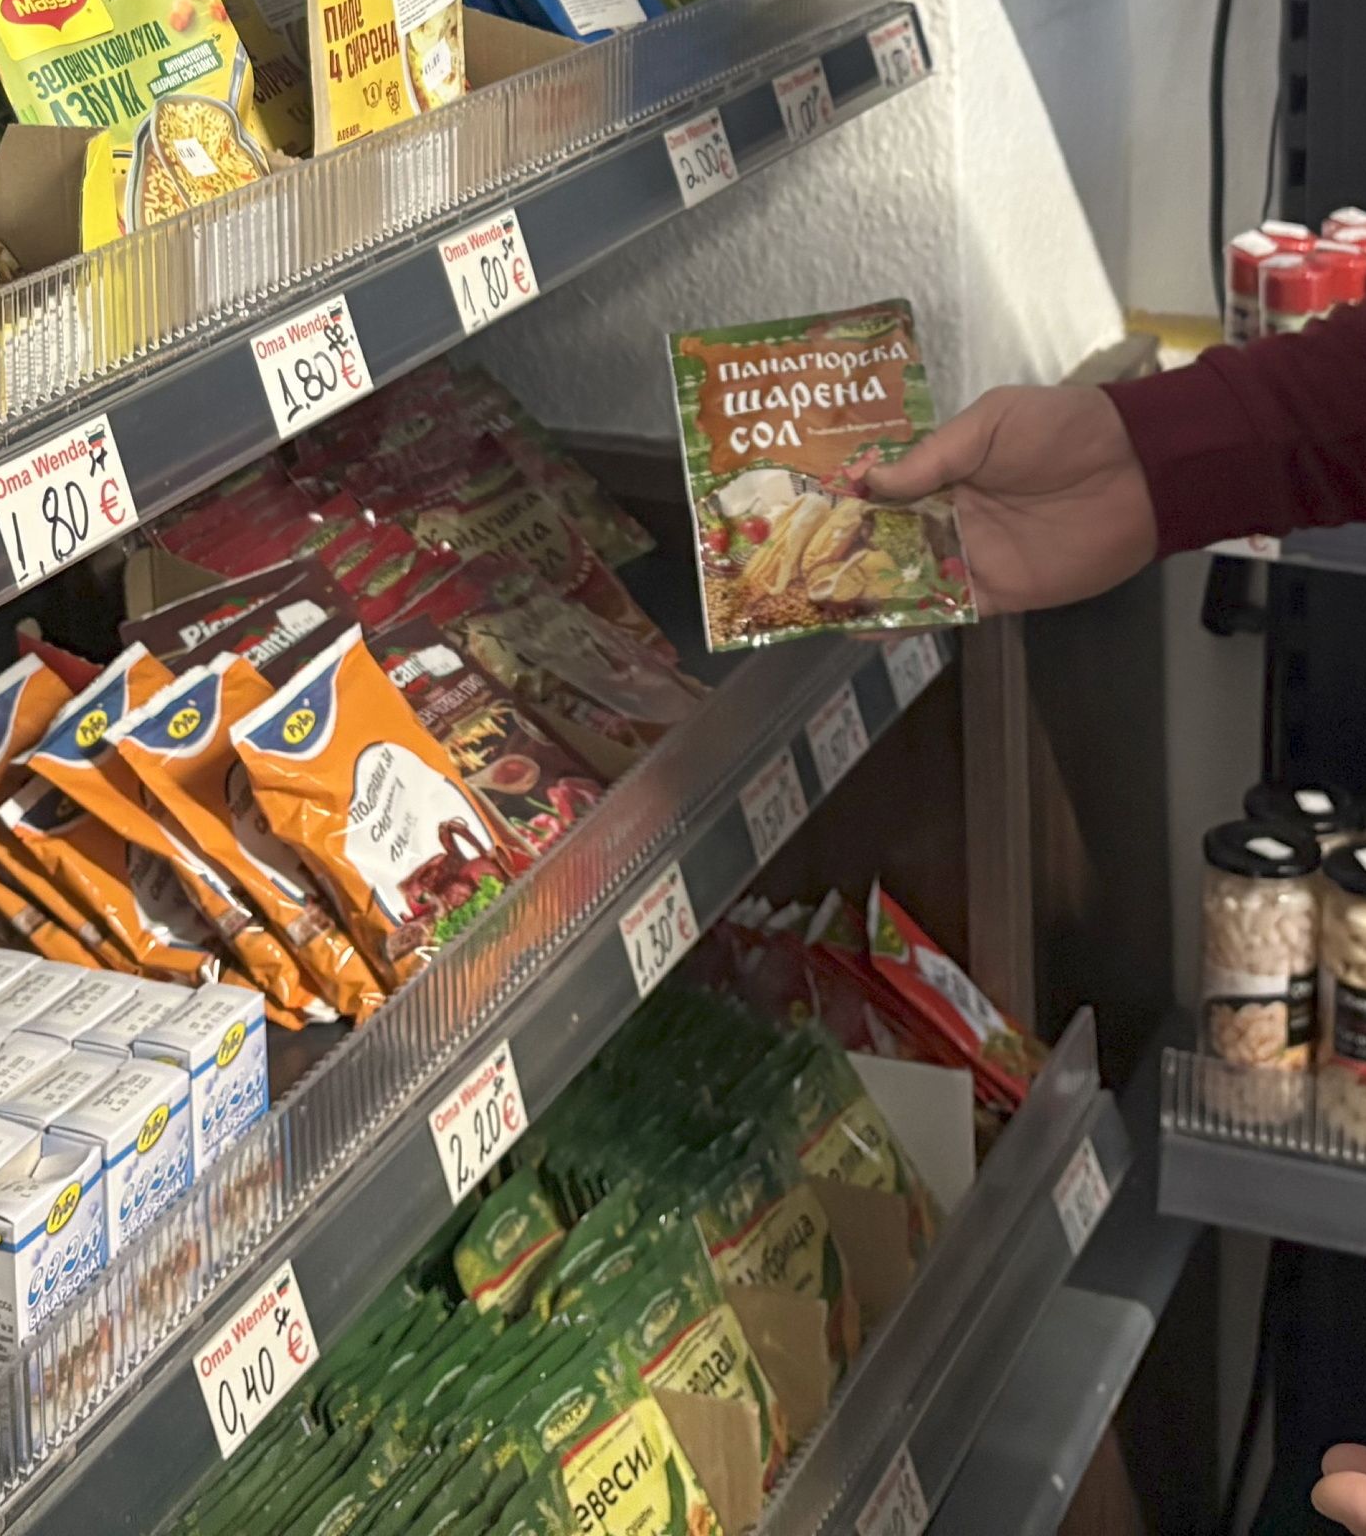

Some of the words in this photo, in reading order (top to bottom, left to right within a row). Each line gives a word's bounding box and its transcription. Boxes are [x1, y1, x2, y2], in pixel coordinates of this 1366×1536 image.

[133, 20, 172, 59] СУПА
[329, 49, 343, 83] 4
[49, 68, 147, 128] АЗБУКА
[719, 149, 735, 181] €
[444, 240, 468, 263] Oma
[468, 224, 503, 251] Wenda
[462, 255, 508, 328] 1,80
[512, 257, 531, 294] €
[256, 332, 287, 360] Oma
[286, 312, 331, 346] Wenda
[341, 349, 363, 390] €
[718, 341, 910, 382] ПАНАГЮРСКА
[723, 375, 887, 419] ШАРЕНА
[31, 438, 87, 479] Wenda
[729, 420, 802, 454] СОЛ
[12, 480, 89, 582] 1,80
[99, 478, 127, 526] €
[435, 1101, 460, 1134] Oma
[458, 1066, 497, 1107] Wenda
[448, 1098, 502, 1194] 2,20
[501, 1091, 520, 1132] €
[200, 1339, 233, 1378] Oma
[230, 1294, 278, 1342] Wenda
[218, 1345, 275, 1436] 0,40
[287, 1319, 311, 1364] €
